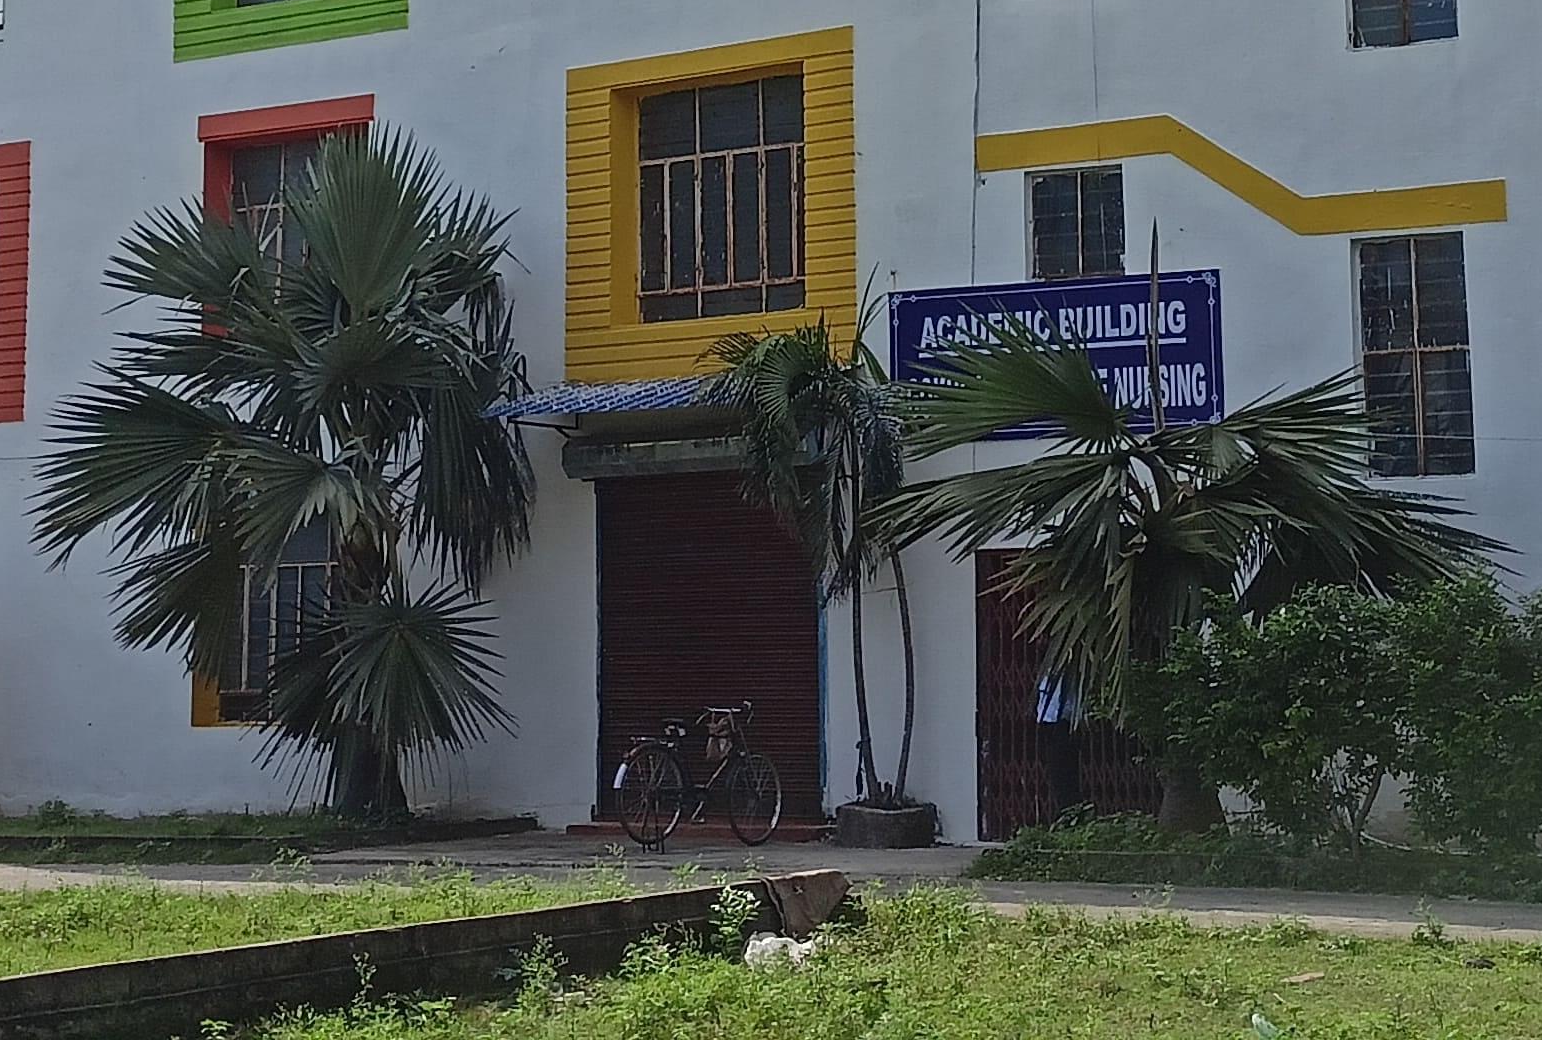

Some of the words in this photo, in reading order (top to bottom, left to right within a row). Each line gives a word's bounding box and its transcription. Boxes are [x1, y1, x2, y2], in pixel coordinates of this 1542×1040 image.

[920, 310, 1051, 349] ACADEMIC
[1059, 300, 1187, 340] BUILDING
[1114, 363, 1207, 410] NURSING
